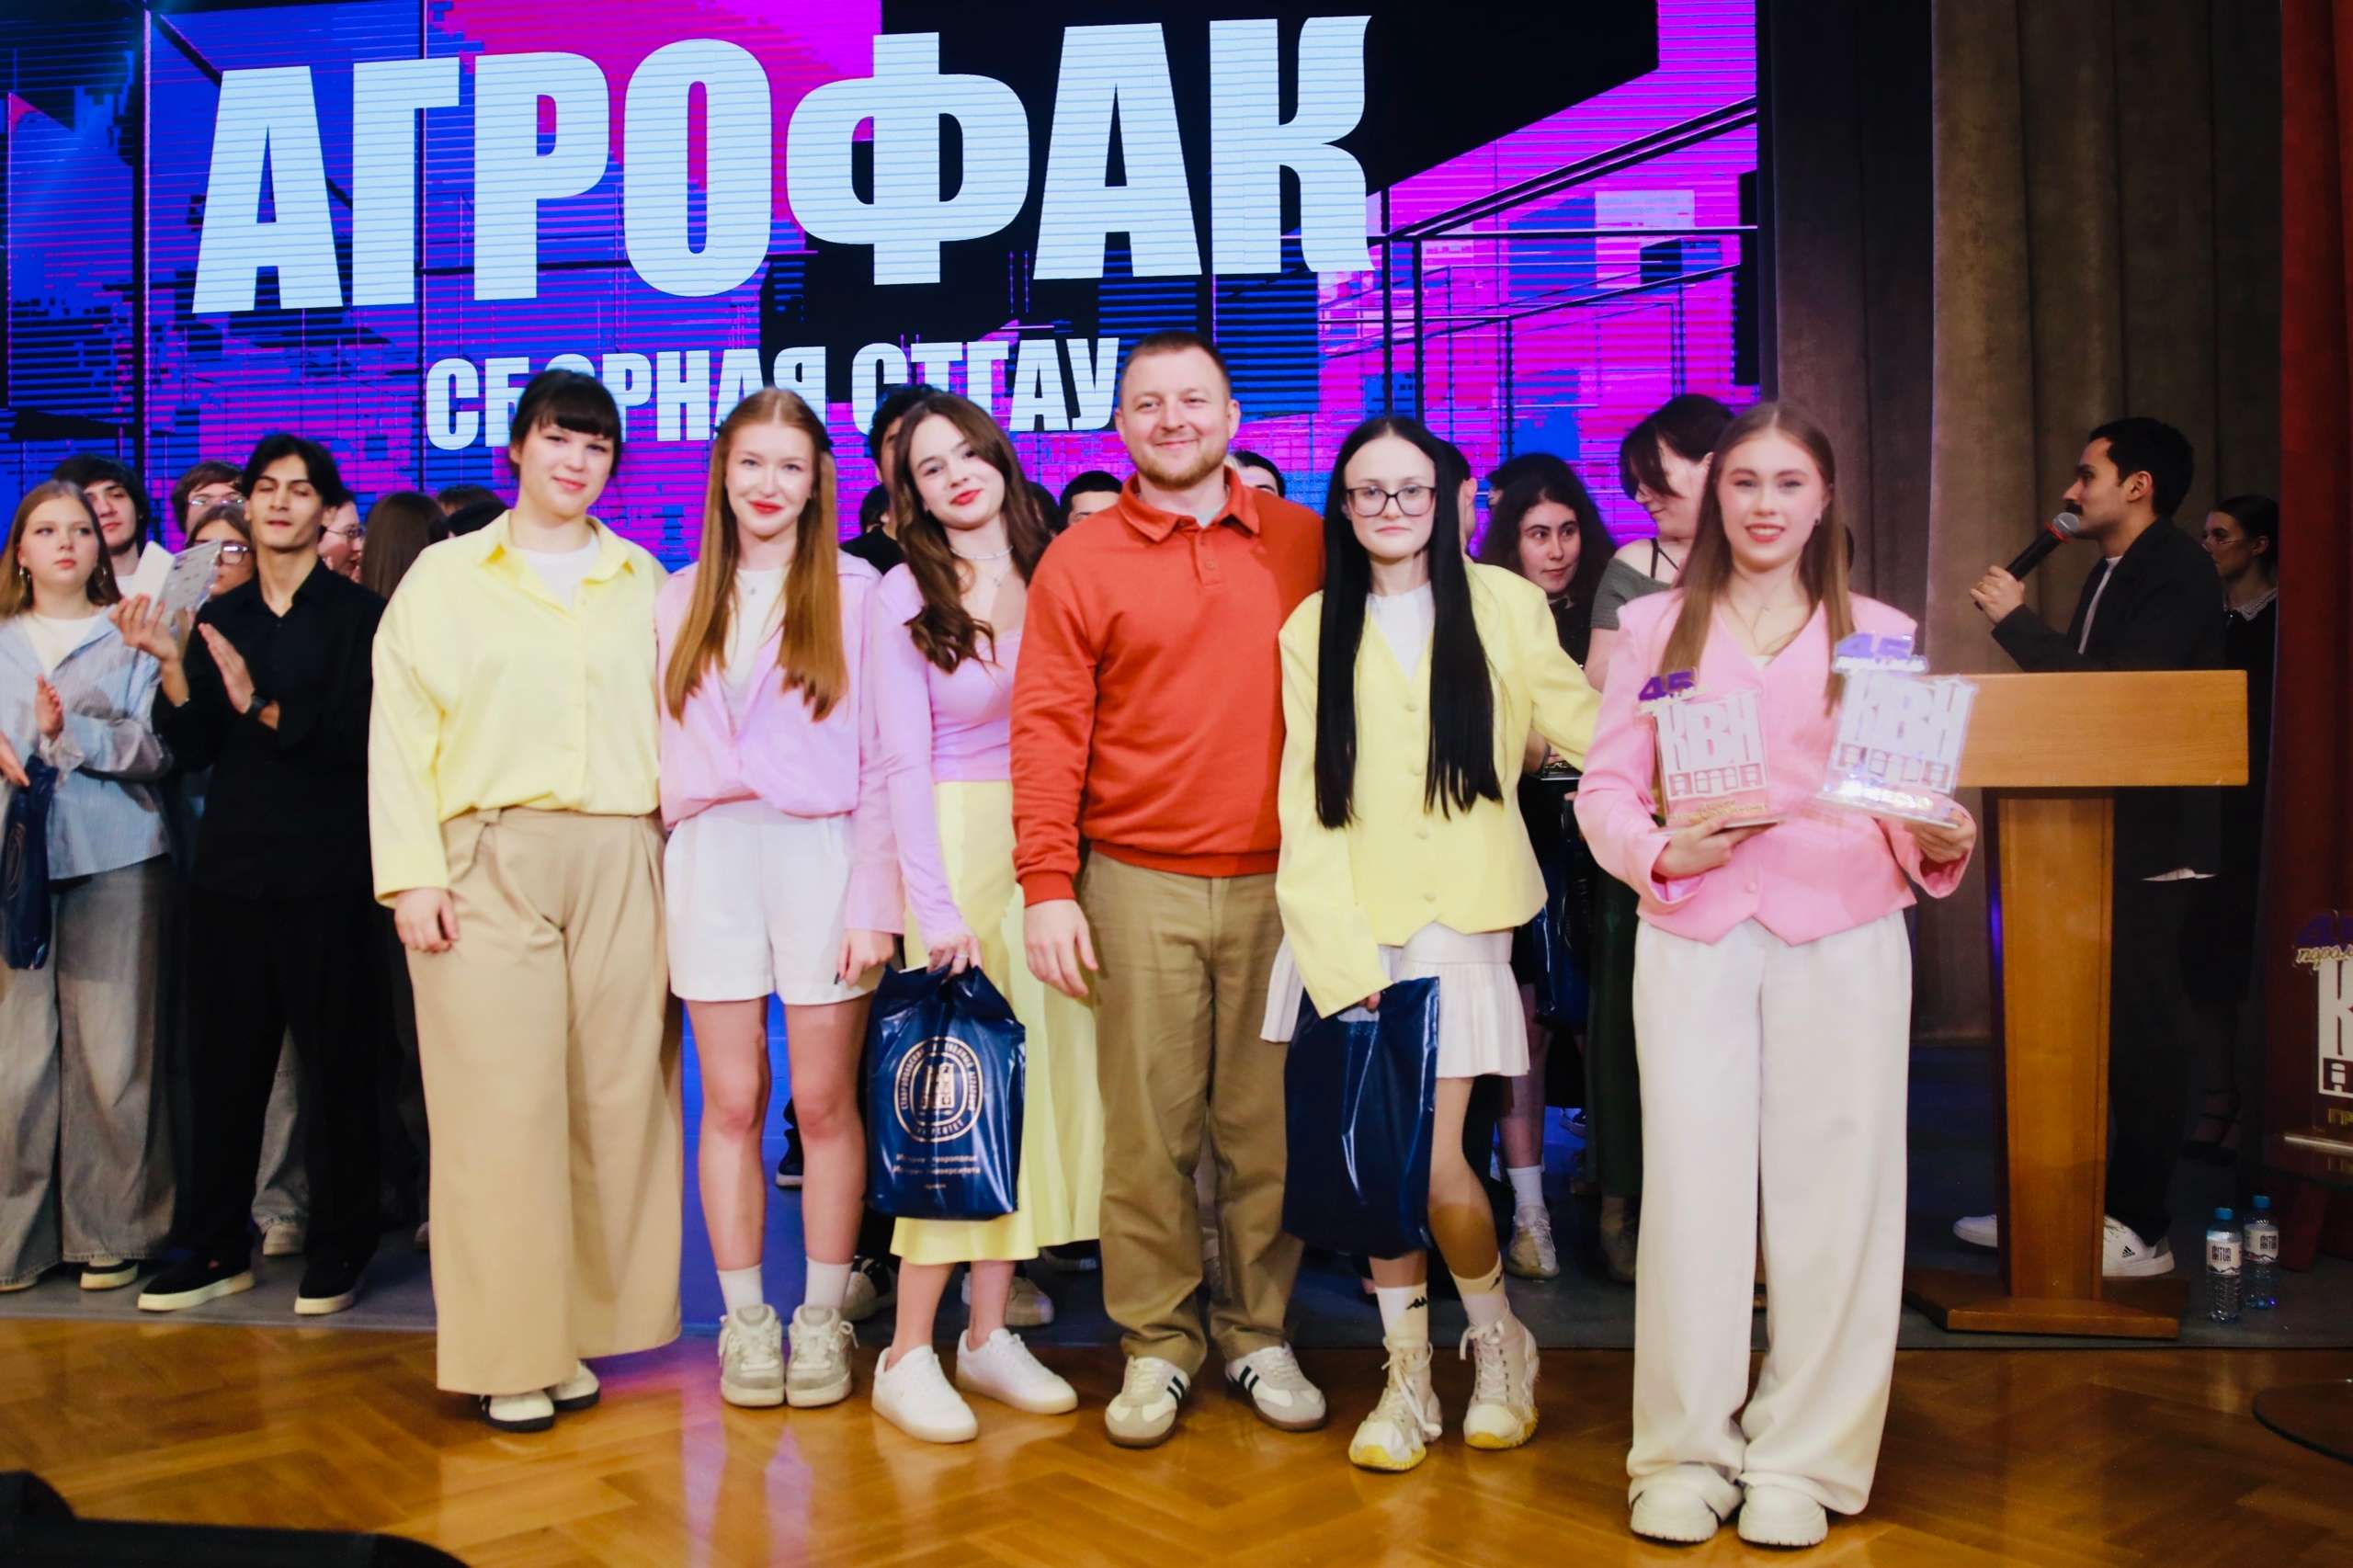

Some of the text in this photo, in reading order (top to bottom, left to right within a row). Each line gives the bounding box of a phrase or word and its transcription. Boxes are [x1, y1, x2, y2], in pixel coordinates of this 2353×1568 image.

[191, 15, 1374, 314] АГРОФАК
[426, 346, 827, 450] СБРНАЯ
[1638, 671, 1695, 701] 45
